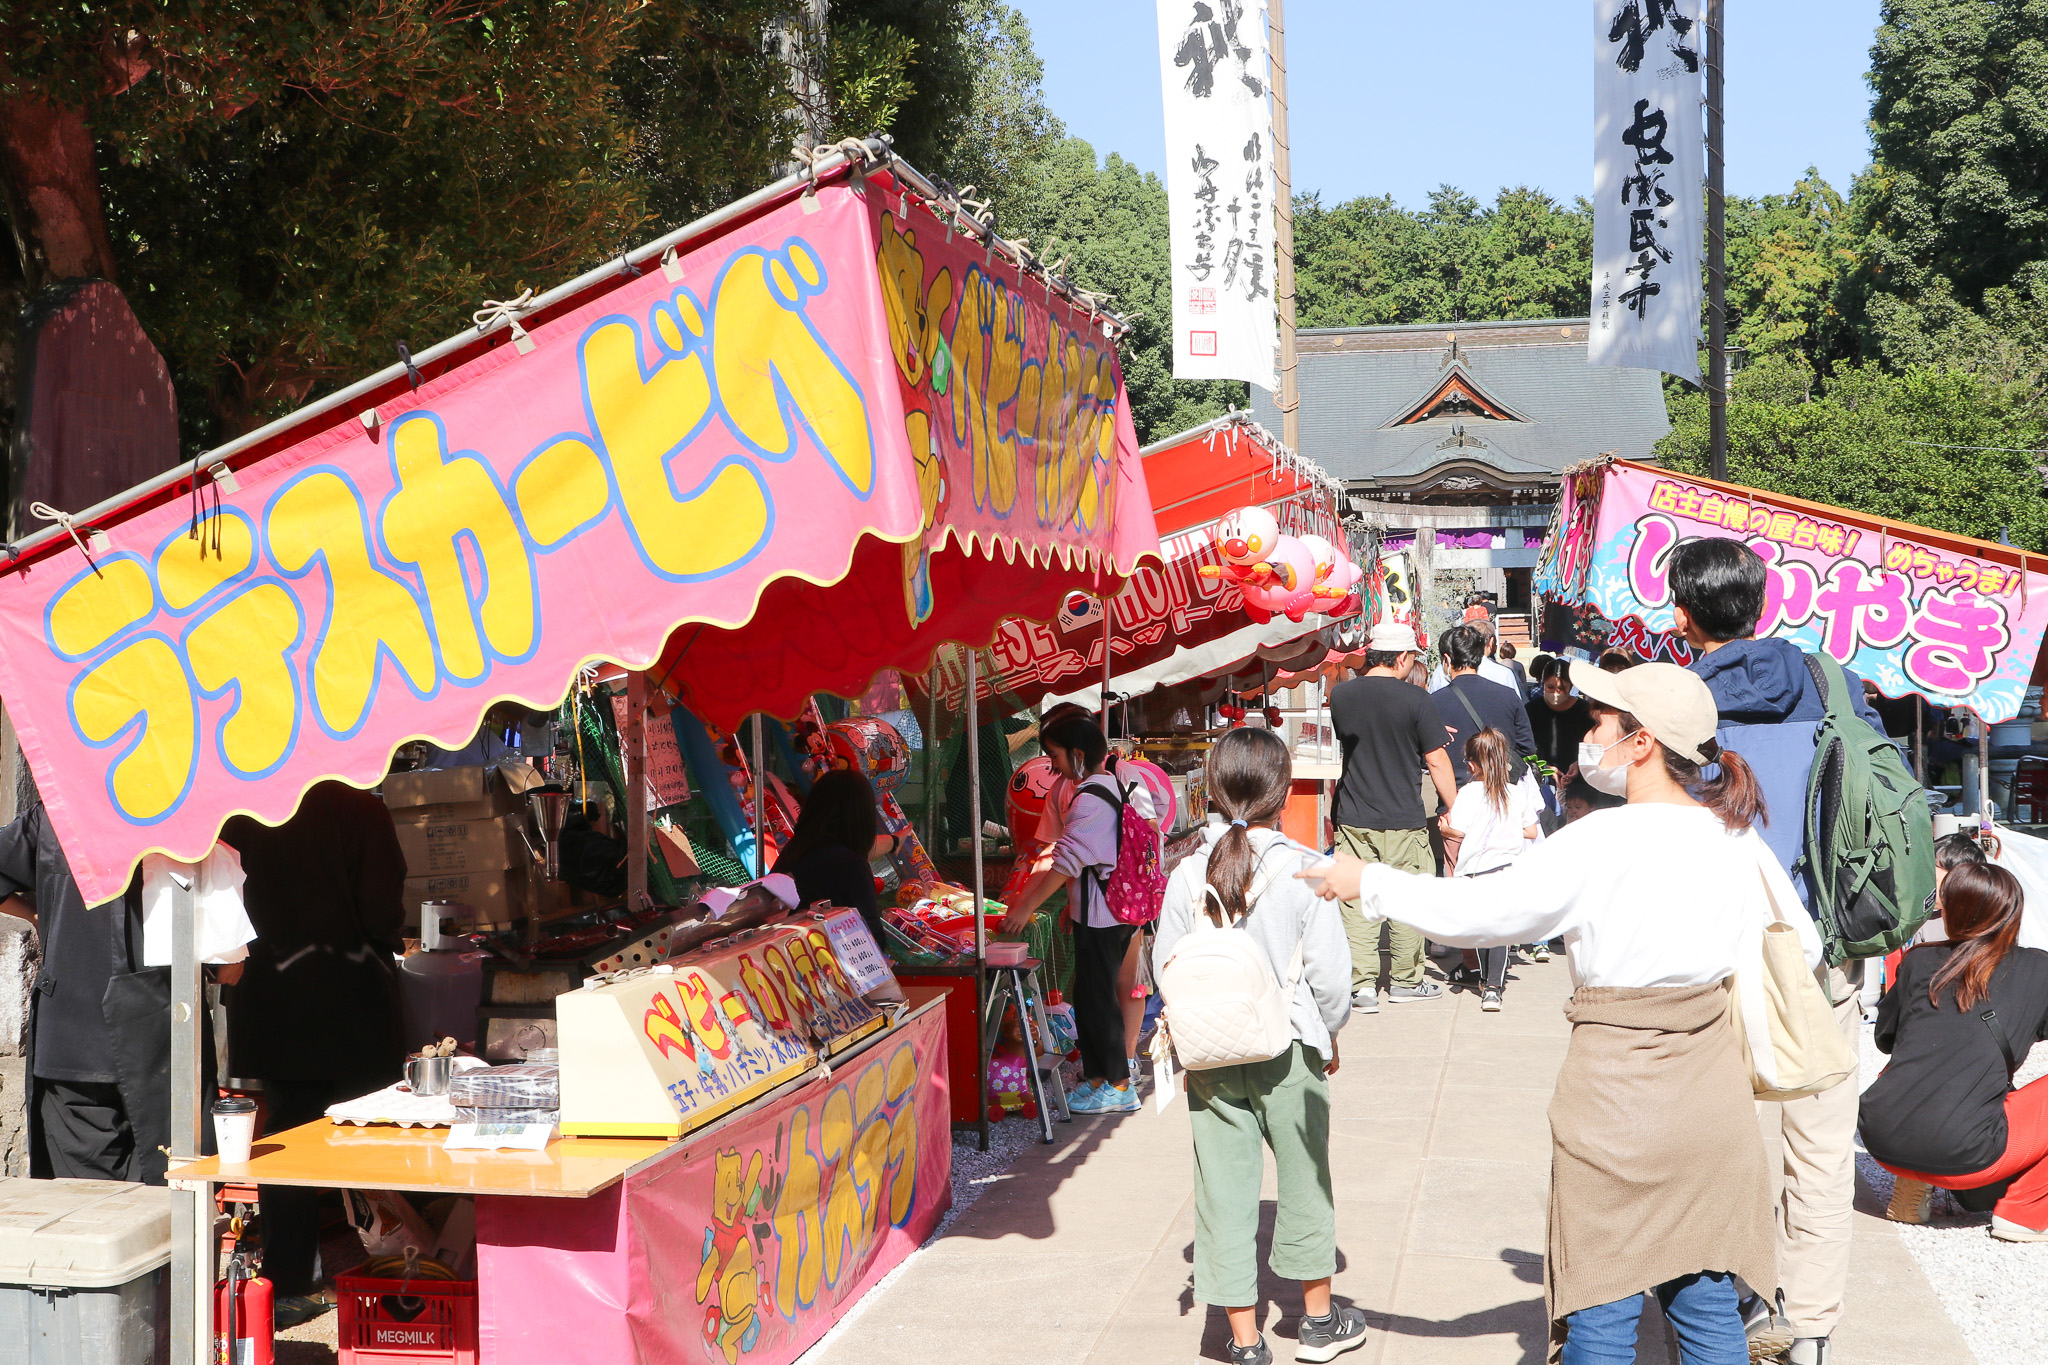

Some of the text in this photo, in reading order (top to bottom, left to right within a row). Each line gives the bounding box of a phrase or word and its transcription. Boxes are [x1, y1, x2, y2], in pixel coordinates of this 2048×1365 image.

[1649, 480, 1861, 557] 店主自慢の屋台味!
[1886, 542, 2021, 597] めちゃうま!
[377, 1330, 435, 1346] MEGMILK
